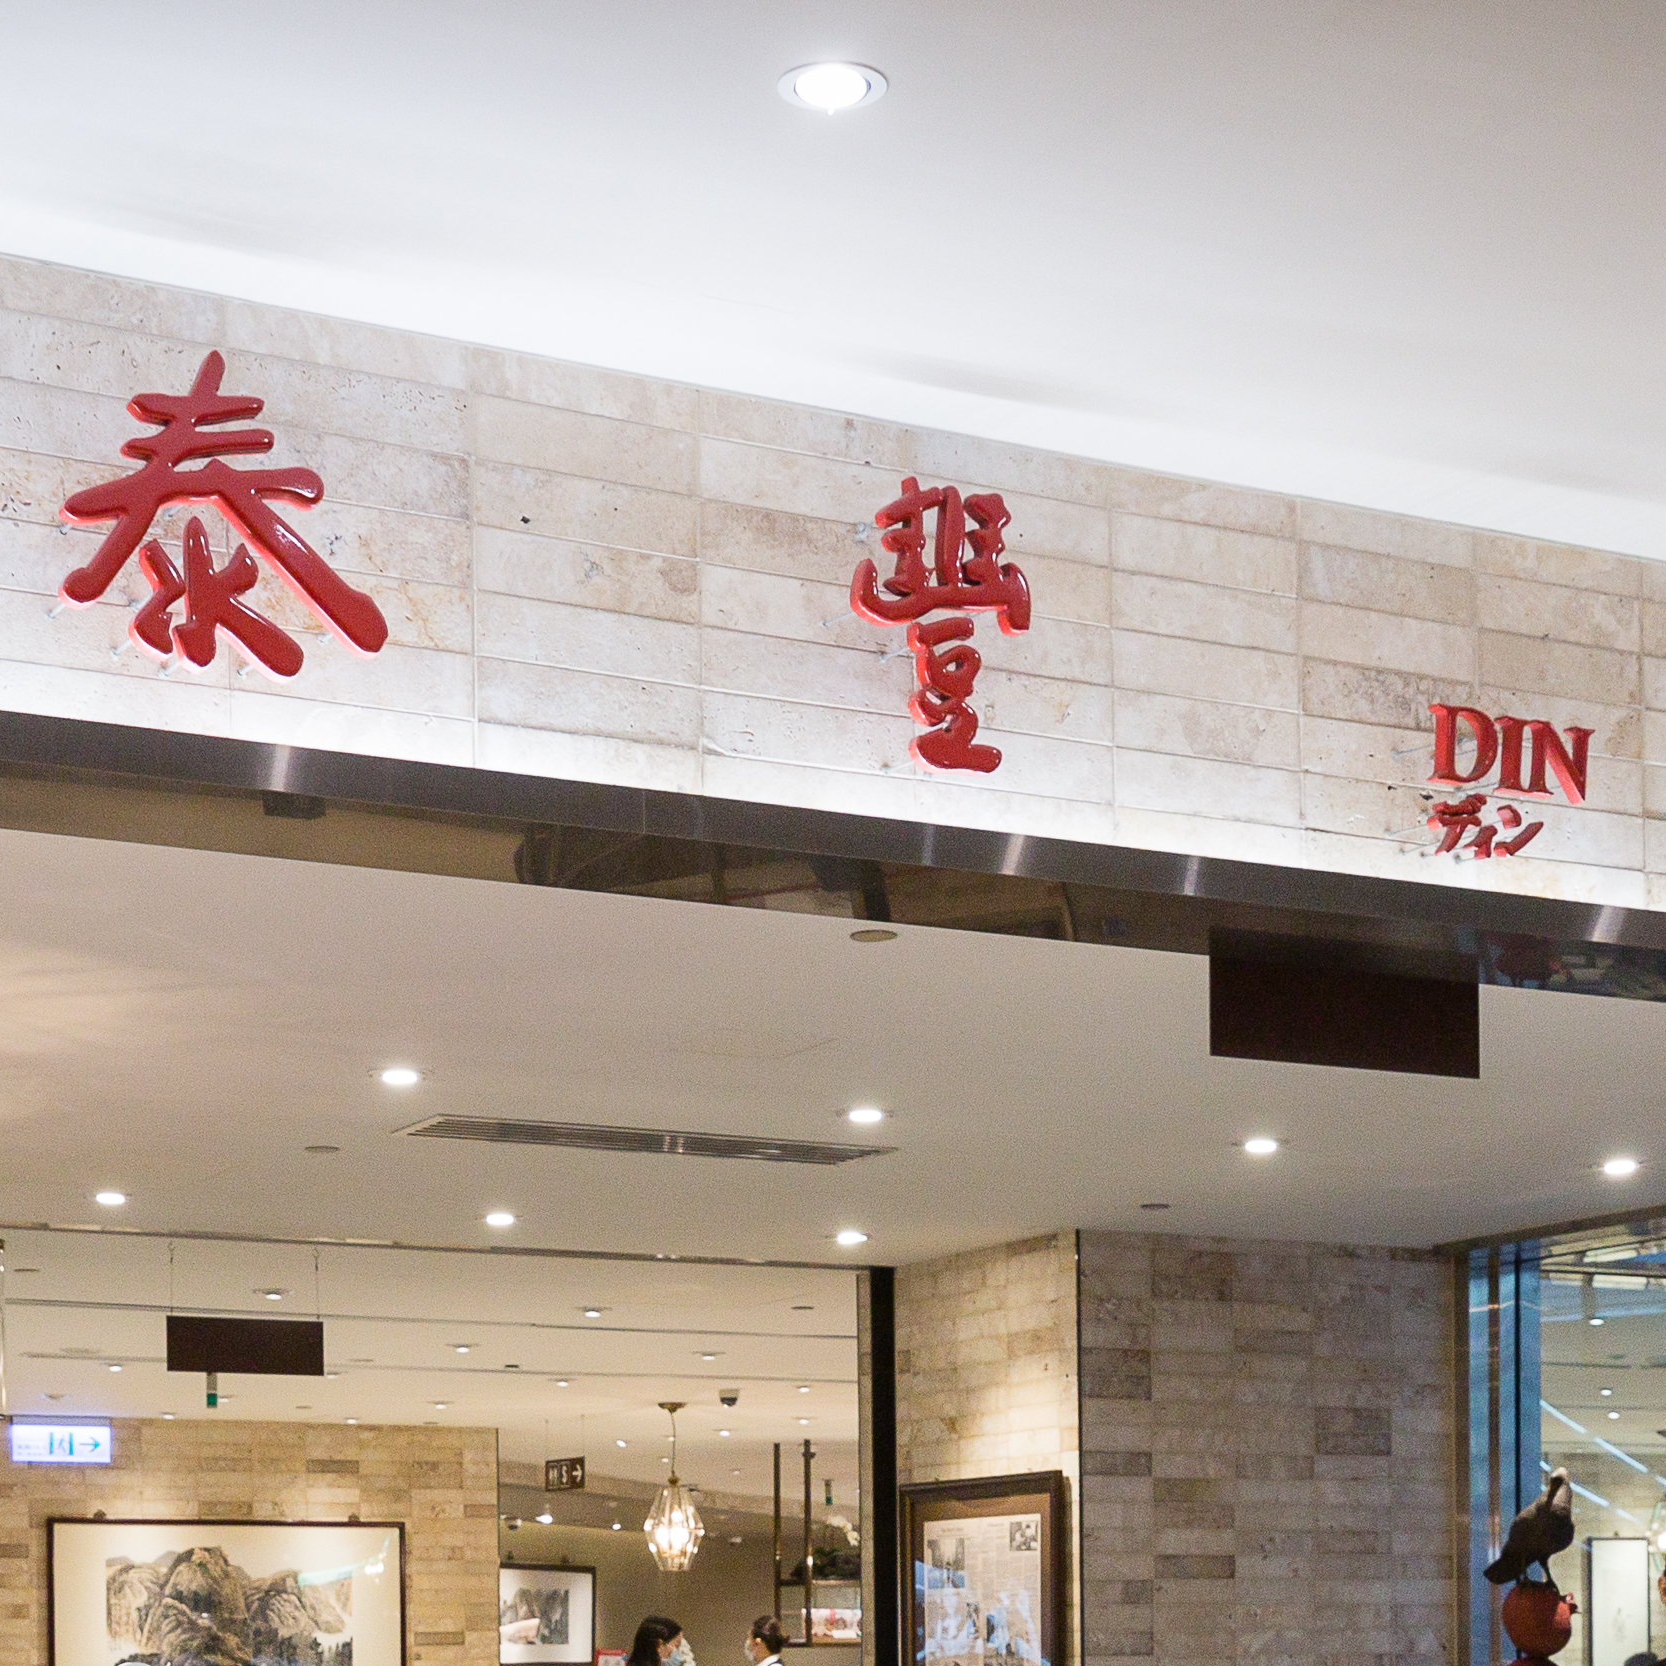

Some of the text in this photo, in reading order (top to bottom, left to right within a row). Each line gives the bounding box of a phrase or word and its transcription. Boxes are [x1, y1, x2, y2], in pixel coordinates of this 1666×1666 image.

[1427, 702, 1595, 804] DIN
[1427, 792, 1544, 860] ディン
